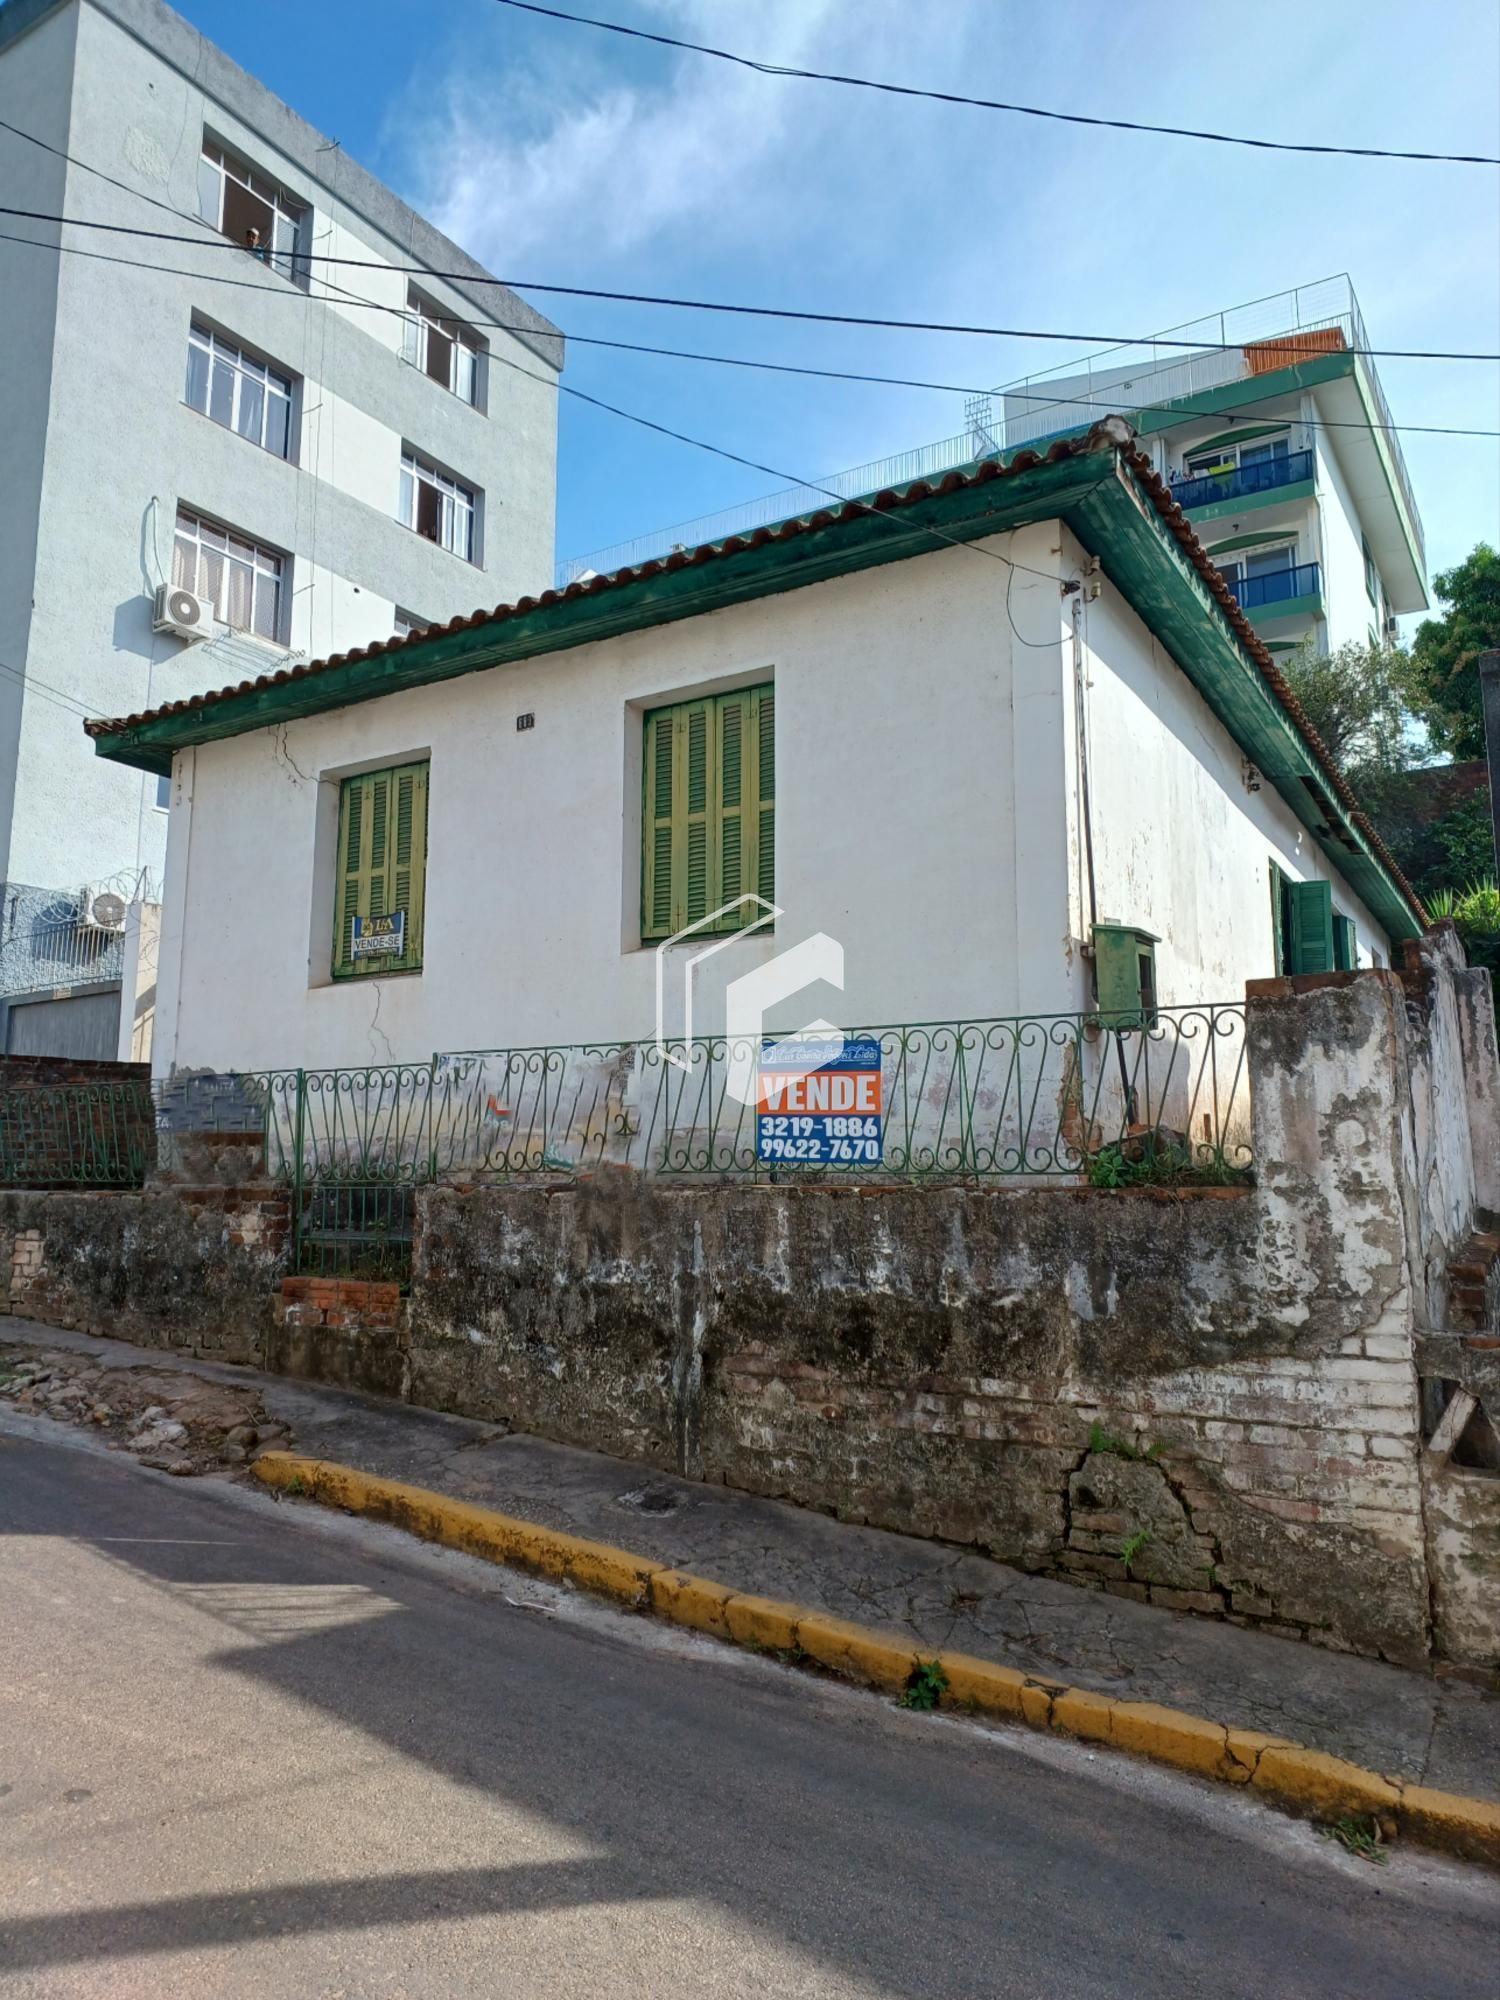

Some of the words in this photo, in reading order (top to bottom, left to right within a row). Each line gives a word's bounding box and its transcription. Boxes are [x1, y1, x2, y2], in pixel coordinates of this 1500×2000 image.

[355, 936, 400, 949] VENDE-SE
[762, 1075, 876, 1111] VENDE
[761, 1117, 878, 1137] 3219-1886
[761, 1138, 879, 1160] 99622-7670
